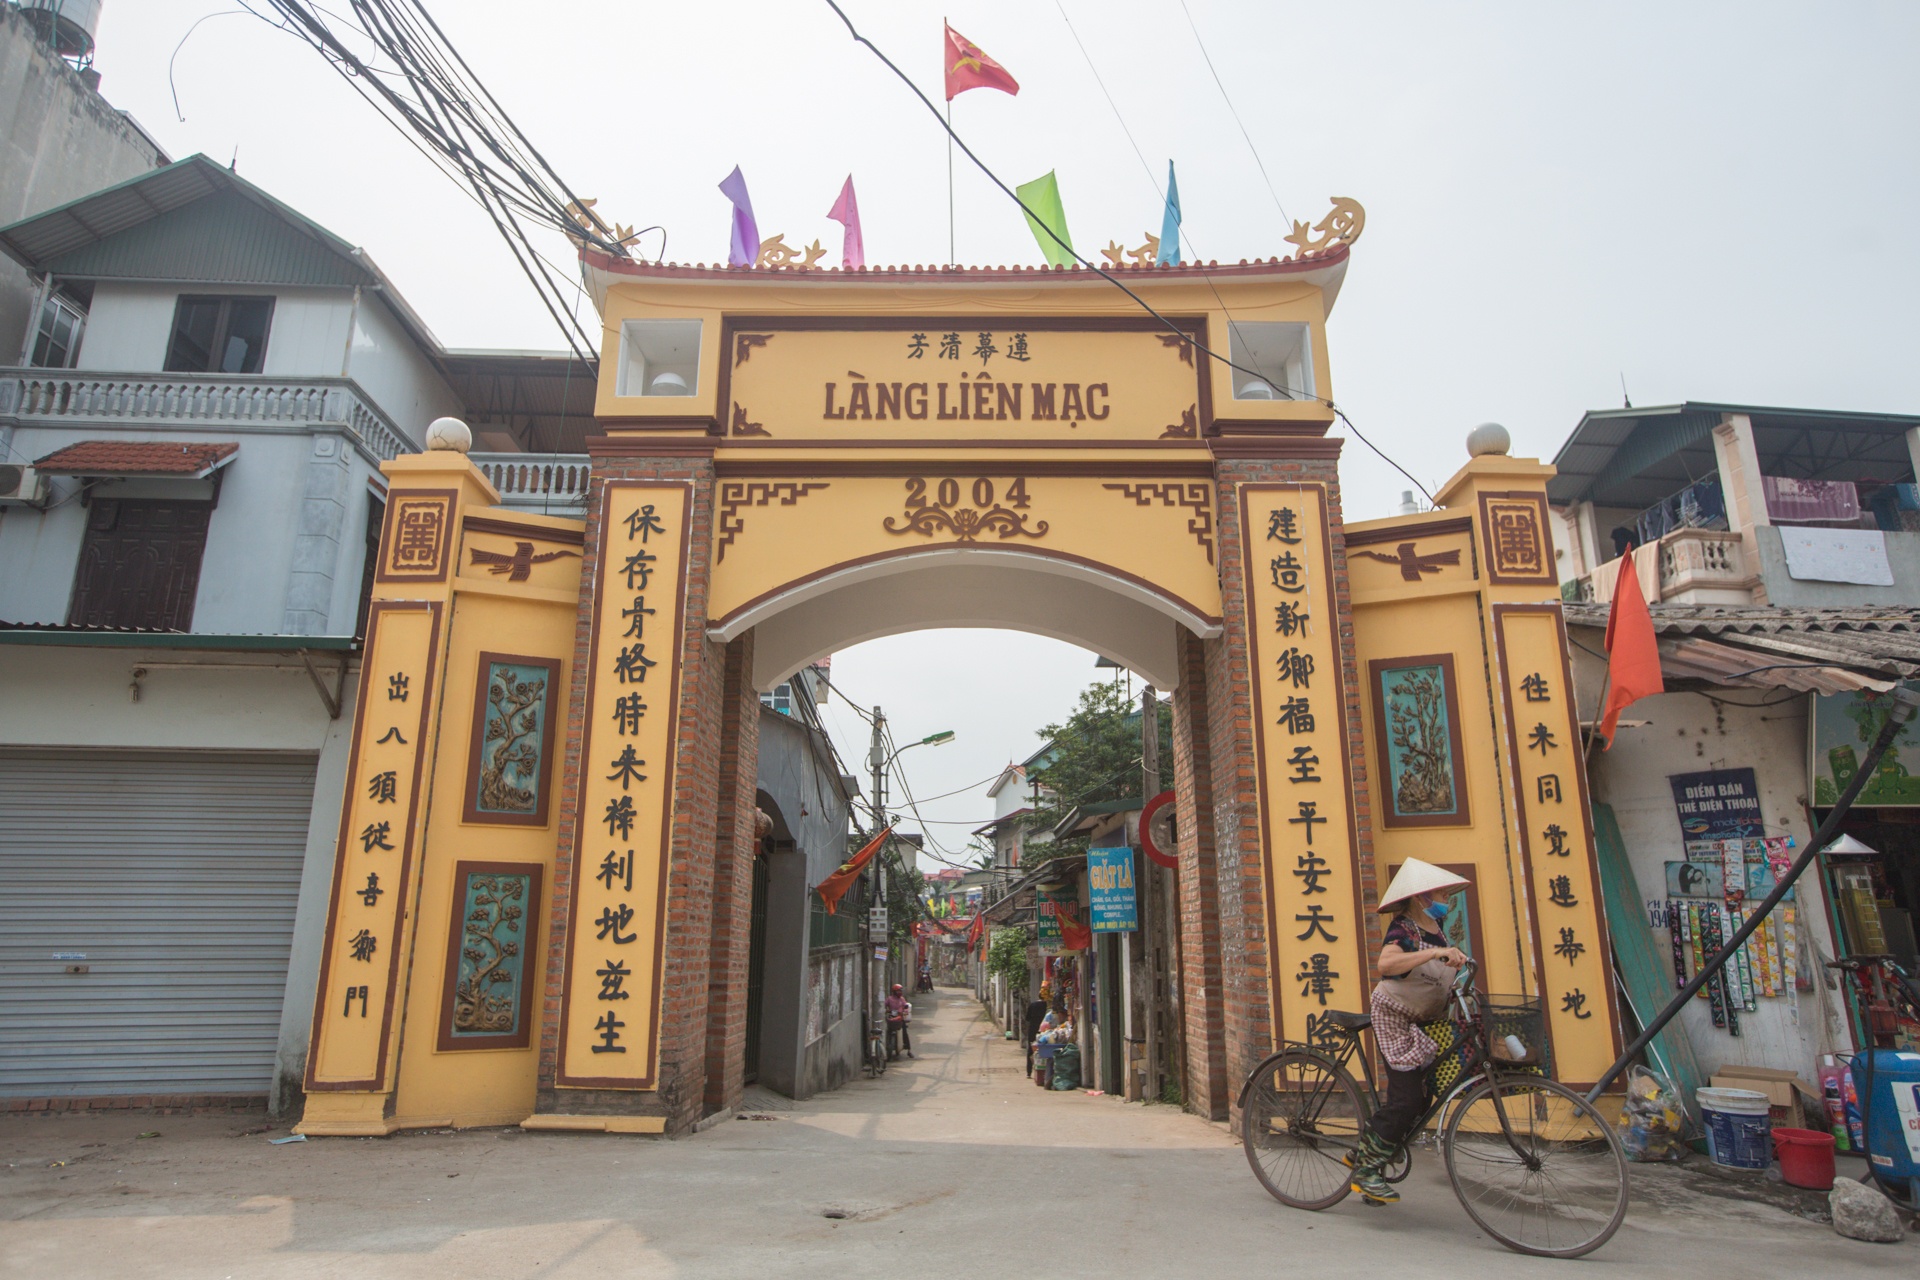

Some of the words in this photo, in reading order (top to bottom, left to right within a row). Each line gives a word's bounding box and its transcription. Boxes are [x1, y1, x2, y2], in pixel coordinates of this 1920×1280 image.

[823, 370, 928, 420] LÀNG
[937, 371, 1023, 421] LIÊN
[1031, 382, 1110, 429] MẠC
[904, 476, 1031, 509] 2004
[1678, 801, 1697, 814] THẺ
[1699, 799, 1723, 814] ĐIỆN
[1725, 798, 1758, 811] THOẠI
[1685, 782, 1716, 799] ĐIỂM
[1718, 782, 1744, 797] BÁN
[1090, 858, 1117, 895] GIẶT
